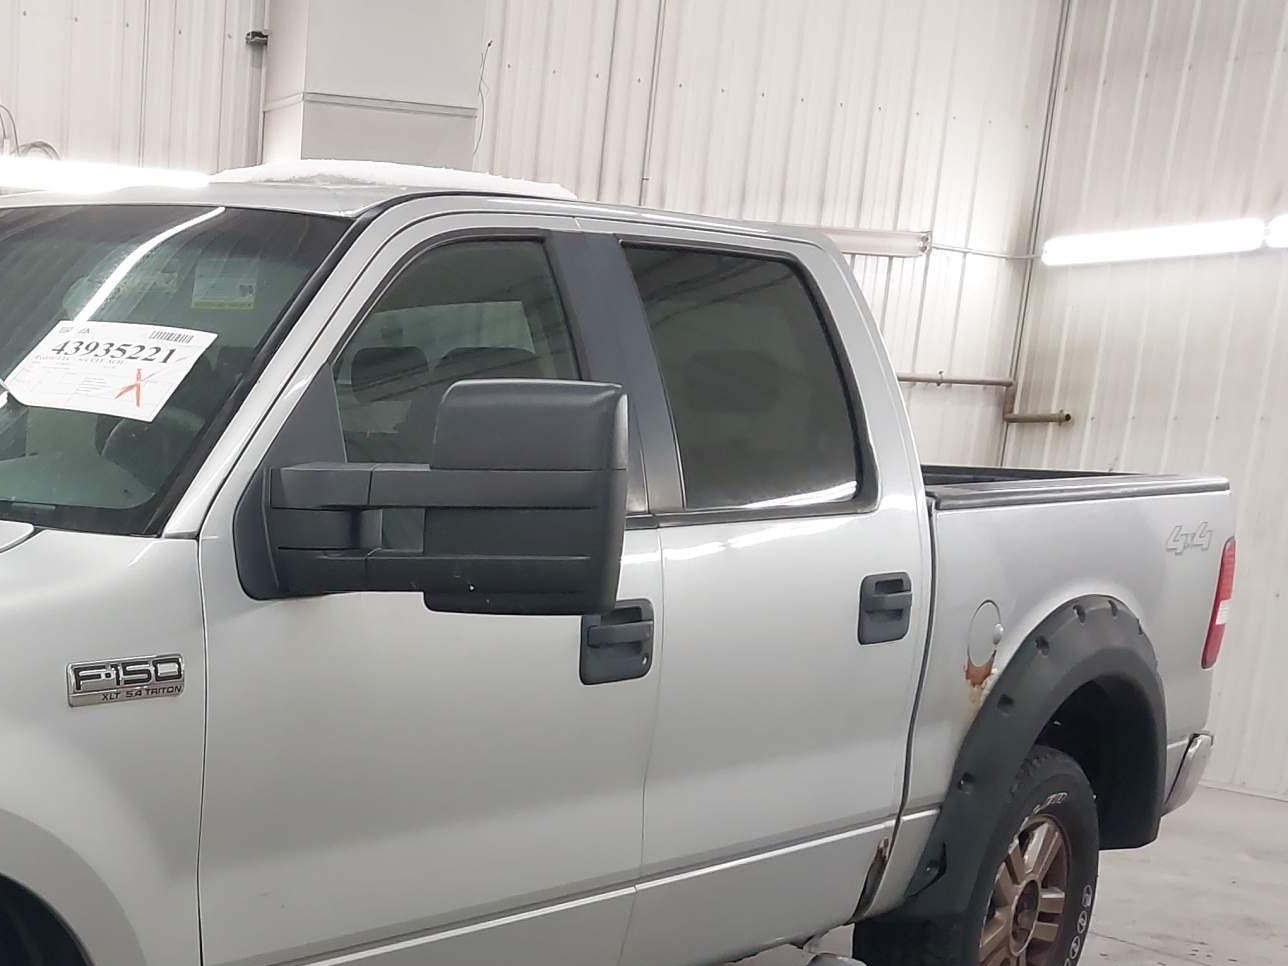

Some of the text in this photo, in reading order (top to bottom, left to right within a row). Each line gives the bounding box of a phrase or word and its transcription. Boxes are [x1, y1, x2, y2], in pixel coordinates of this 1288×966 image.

[51, 339, 177, 364] 43935221
[1165, 520, 1213, 556] 4x4
[72, 656, 183, 691] F-150
[101, 692, 120, 702] XLT
[144, 685, 183, 696] TRITON
